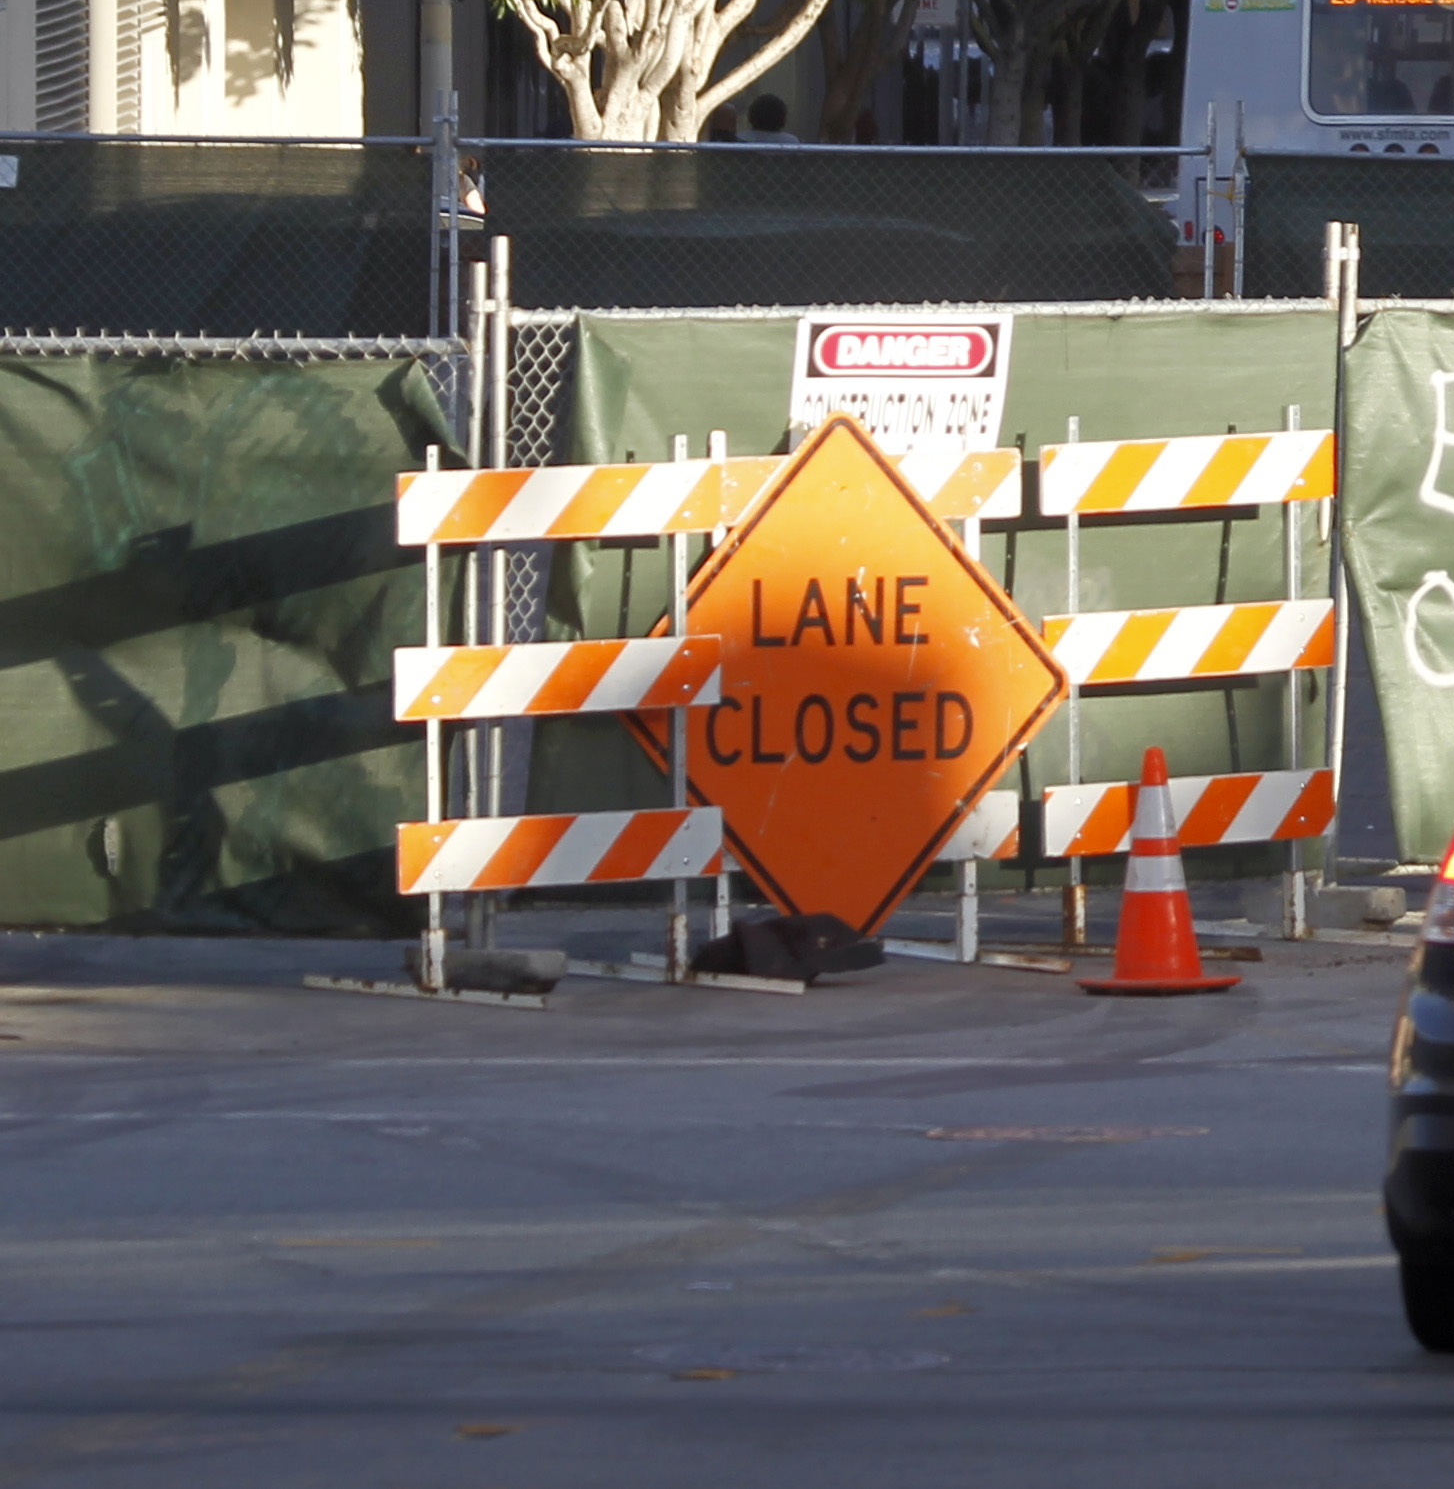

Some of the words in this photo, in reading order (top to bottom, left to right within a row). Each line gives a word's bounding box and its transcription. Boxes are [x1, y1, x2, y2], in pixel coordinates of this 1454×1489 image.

[1339, 128, 1450, 141] www.sfmta.com
[835, 334, 971, 367] DANGER
[945, 393, 991, 434] ZONE
[752, 576, 929, 647] LANE
[705, 691, 974, 766] CLOSED
